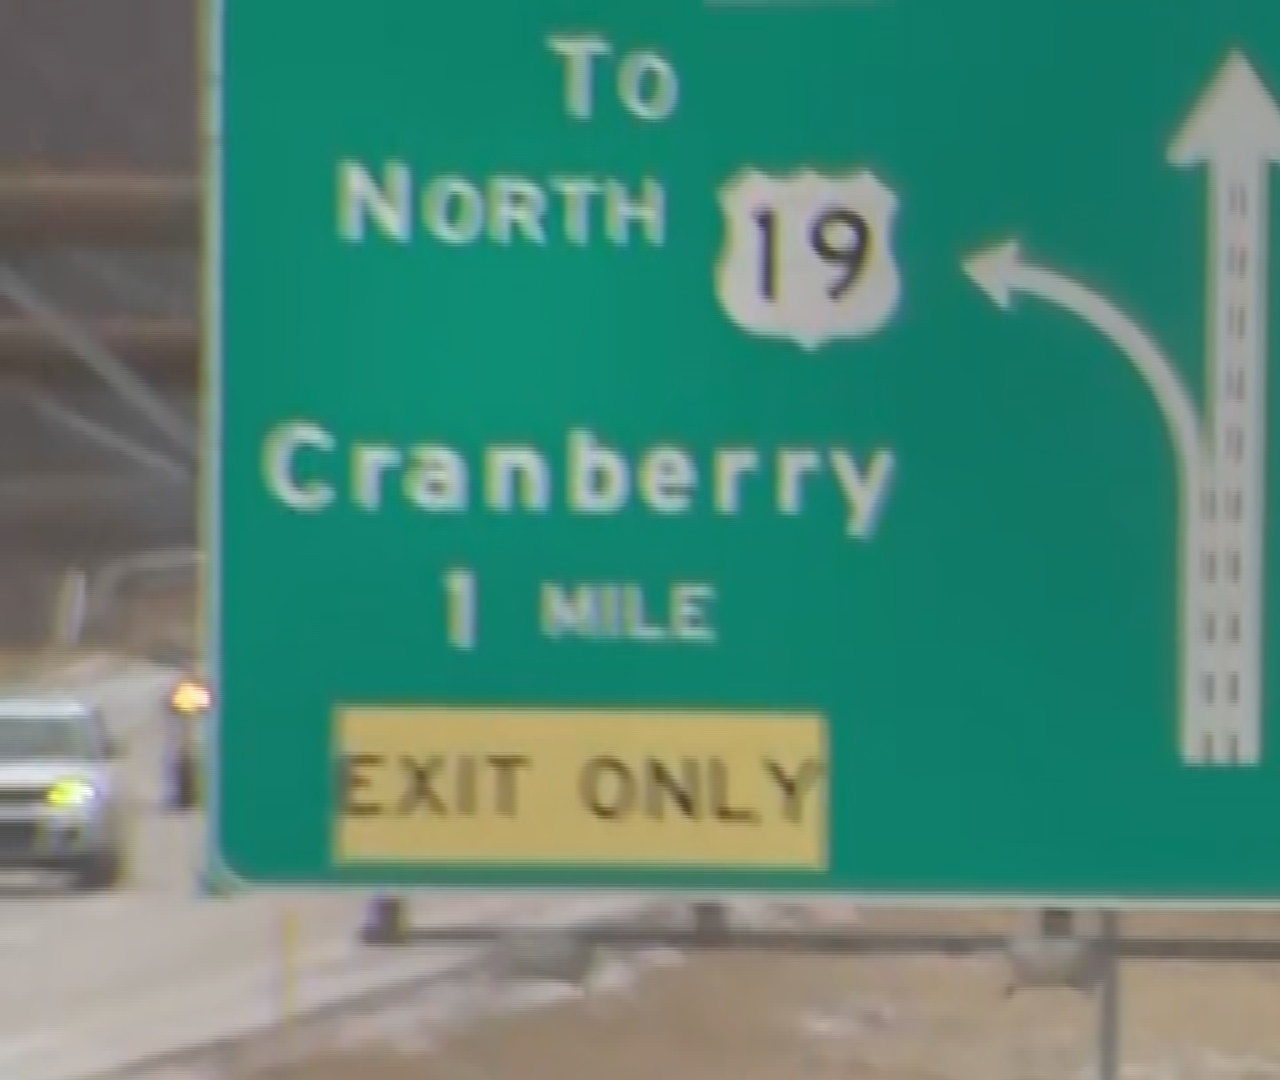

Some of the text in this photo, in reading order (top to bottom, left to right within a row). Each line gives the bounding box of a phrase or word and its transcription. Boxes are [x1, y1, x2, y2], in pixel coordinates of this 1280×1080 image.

[337, 162, 667, 246] NORTH
[754, 207, 872, 302] 19
[261, 422, 894, 538] Cranberry
[444, 567, 717, 650] 1 MILE
[338, 754, 818, 824] EXIT ONLY
